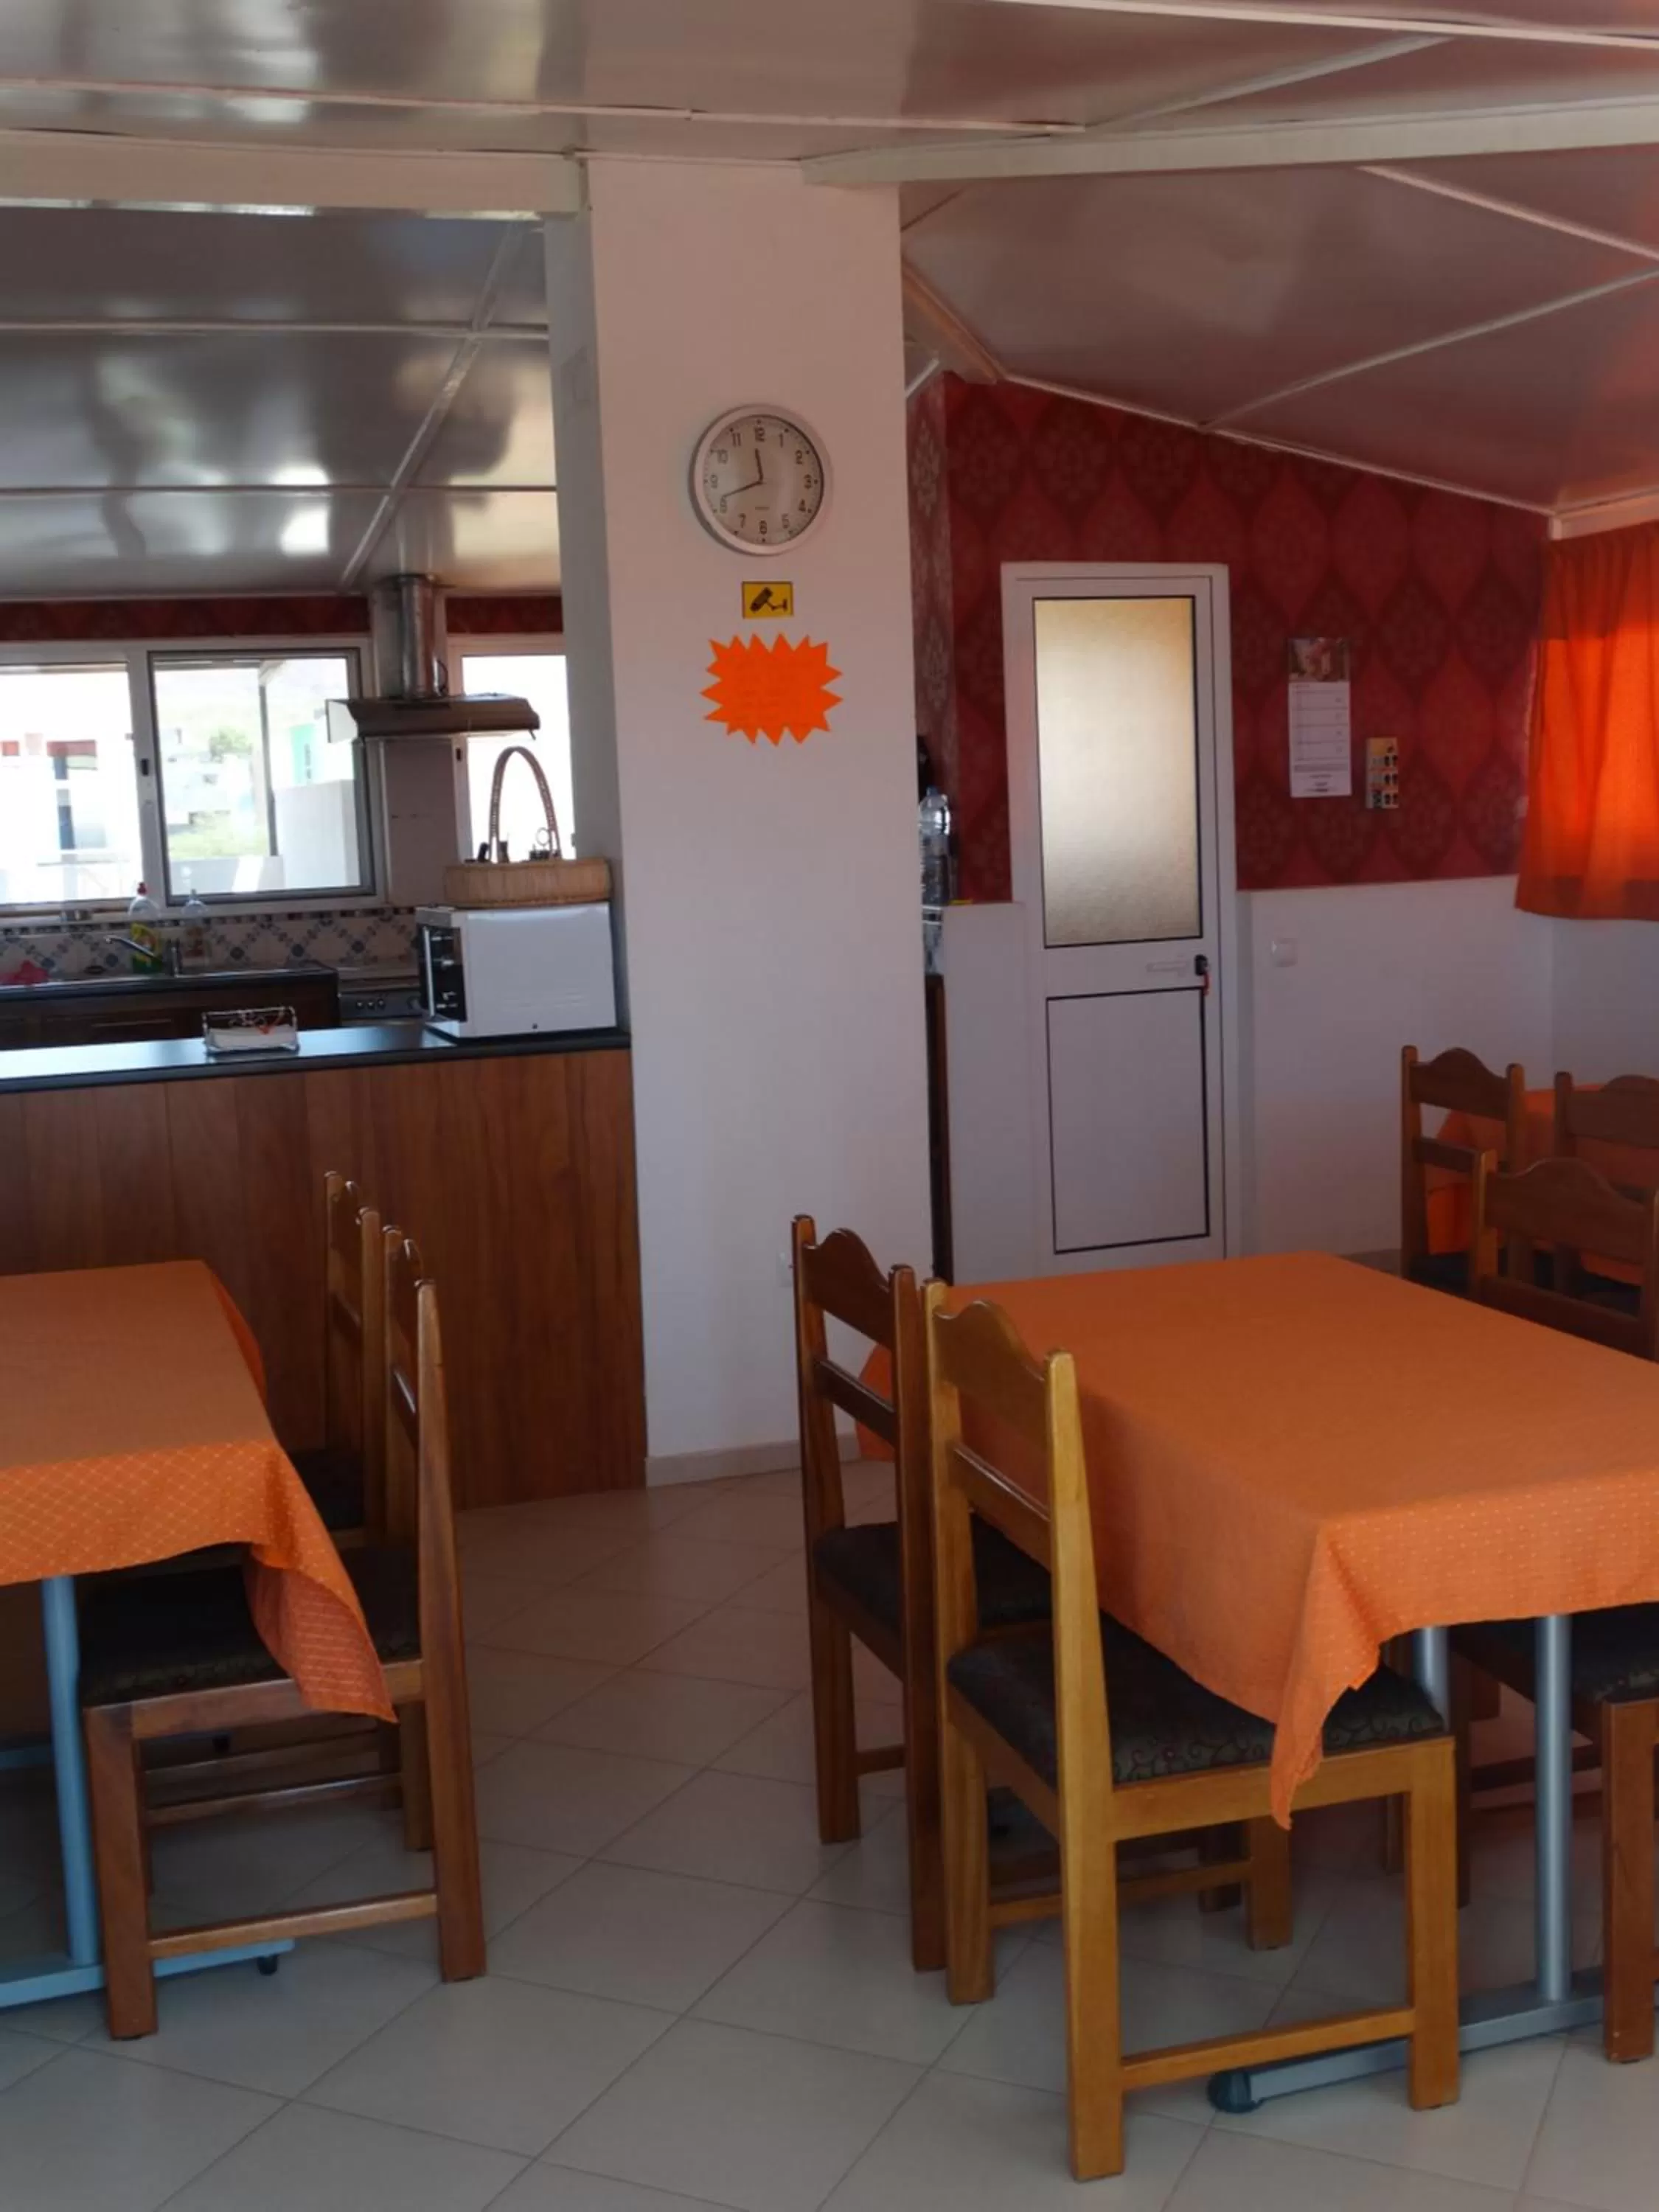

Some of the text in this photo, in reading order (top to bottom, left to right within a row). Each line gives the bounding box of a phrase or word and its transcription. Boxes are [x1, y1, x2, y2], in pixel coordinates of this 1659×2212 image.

[732, 433, 741, 447] 11
[754, 427, 765, 442] 12
[779, 433, 784, 448] 1
[796, 450, 803, 465] 2
[711, 474, 717, 488] 9
[804, 474, 812, 489] 3
[739, 513, 746, 528] 7
[759, 520, 767, 535] 6
[782, 514, 790, 529] 5
